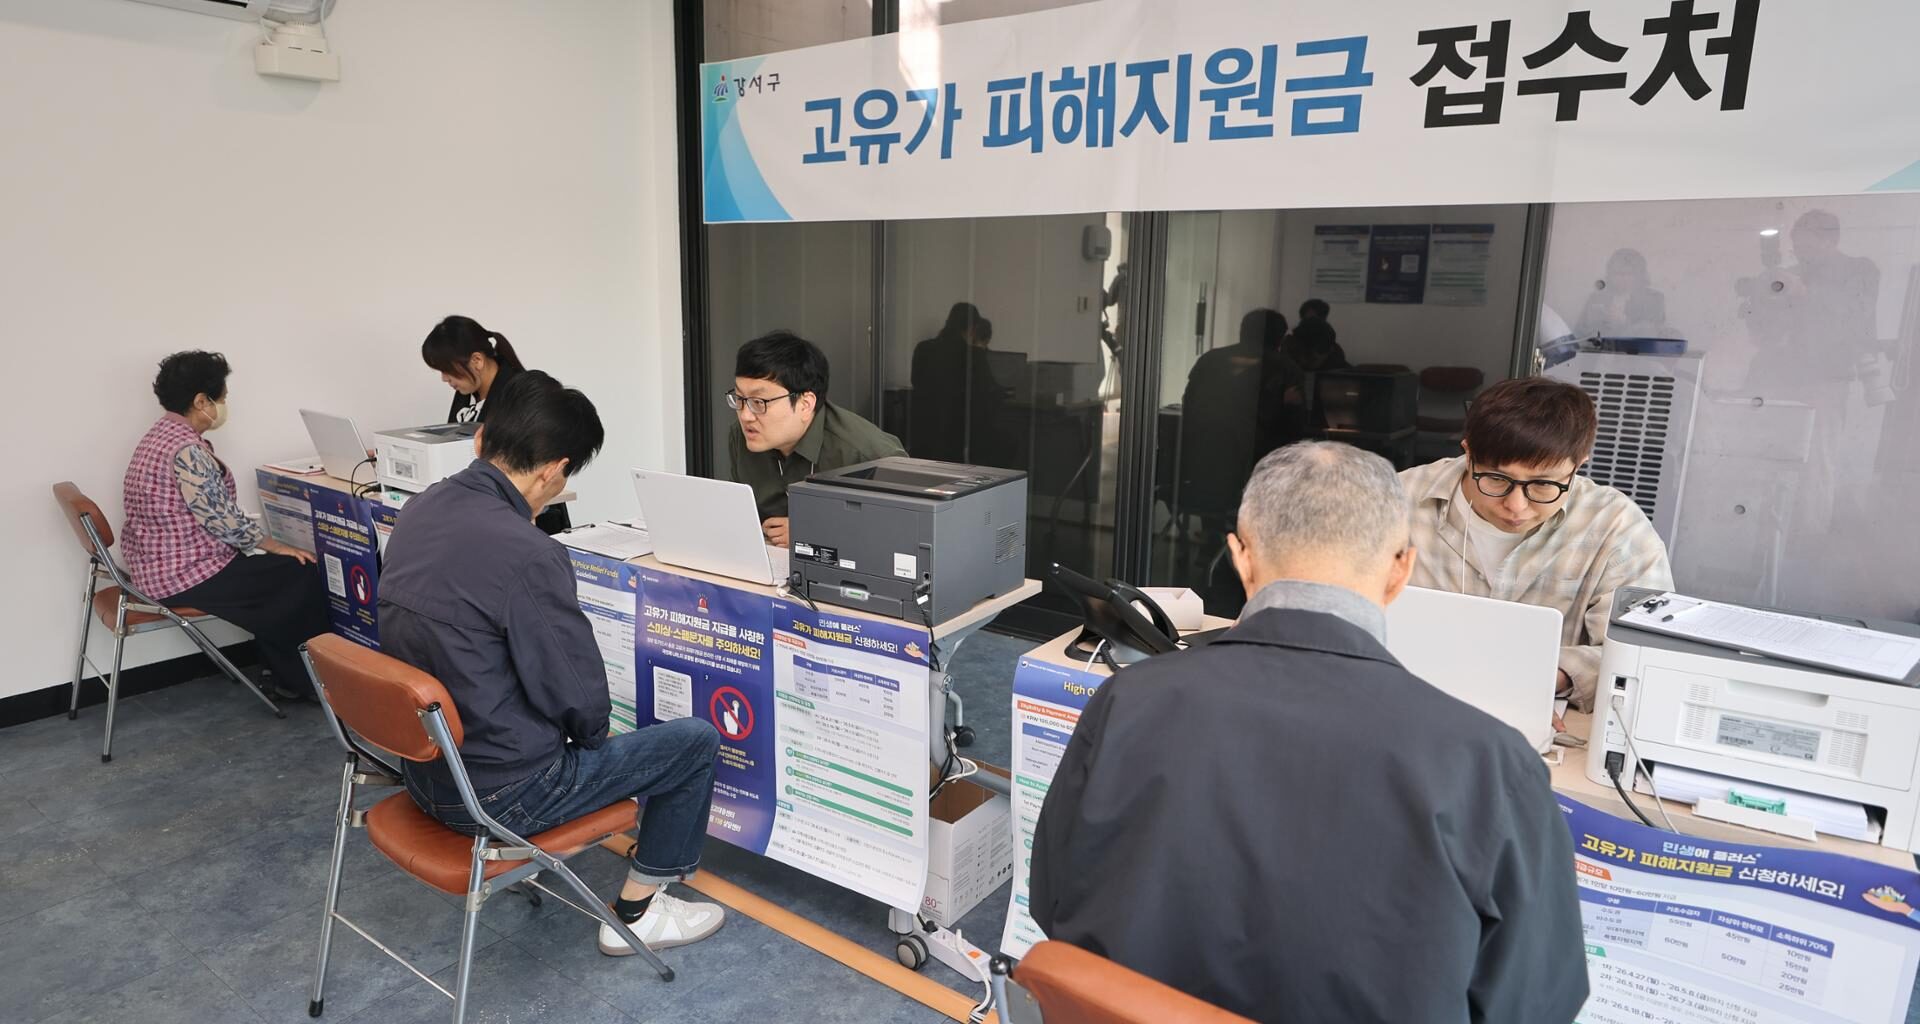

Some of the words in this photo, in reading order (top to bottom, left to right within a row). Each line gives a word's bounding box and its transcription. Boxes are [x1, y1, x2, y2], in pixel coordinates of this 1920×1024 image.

[733, 73, 781, 97] 강서구
[802, 83, 962, 165] 고유가
[983, 35, 1374, 153] 피해지원금
[1408, 0, 1760, 129] 접수처
[643, 605, 668, 621] 고유가
[670, 611, 710, 631] 피해지원금
[711, 621, 737, 638] 지급을
[739, 628, 765, 645] 사칭한
[819, 618, 840, 630] 민생에
[792, 619, 813, 636] 고유가
[813, 628, 853, 644] 피해지원금
[854, 636, 898, 654] 신청하세요!
[716, 638, 761, 660] 주의하세요!
[1064, 681, 1085, 696] High
[1663, 841, 1710, 859] 민생에
[1713, 850, 1758, 864] 플러스
[1581, 833, 1636, 862] 고유가
[1639, 852, 1734, 878] 피해지원금
[1738, 867, 1845, 900] 신청하세요!
[925, 895, 937, 909] 80
[1808, 940, 1828, 953] 70%
[1721, 952, 1747, 966] 50만원
[1787, 949, 1811, 962] 10만원
[1780, 971, 1807, 985] 20만원
[1778, 982, 1805, 996] 25만원
